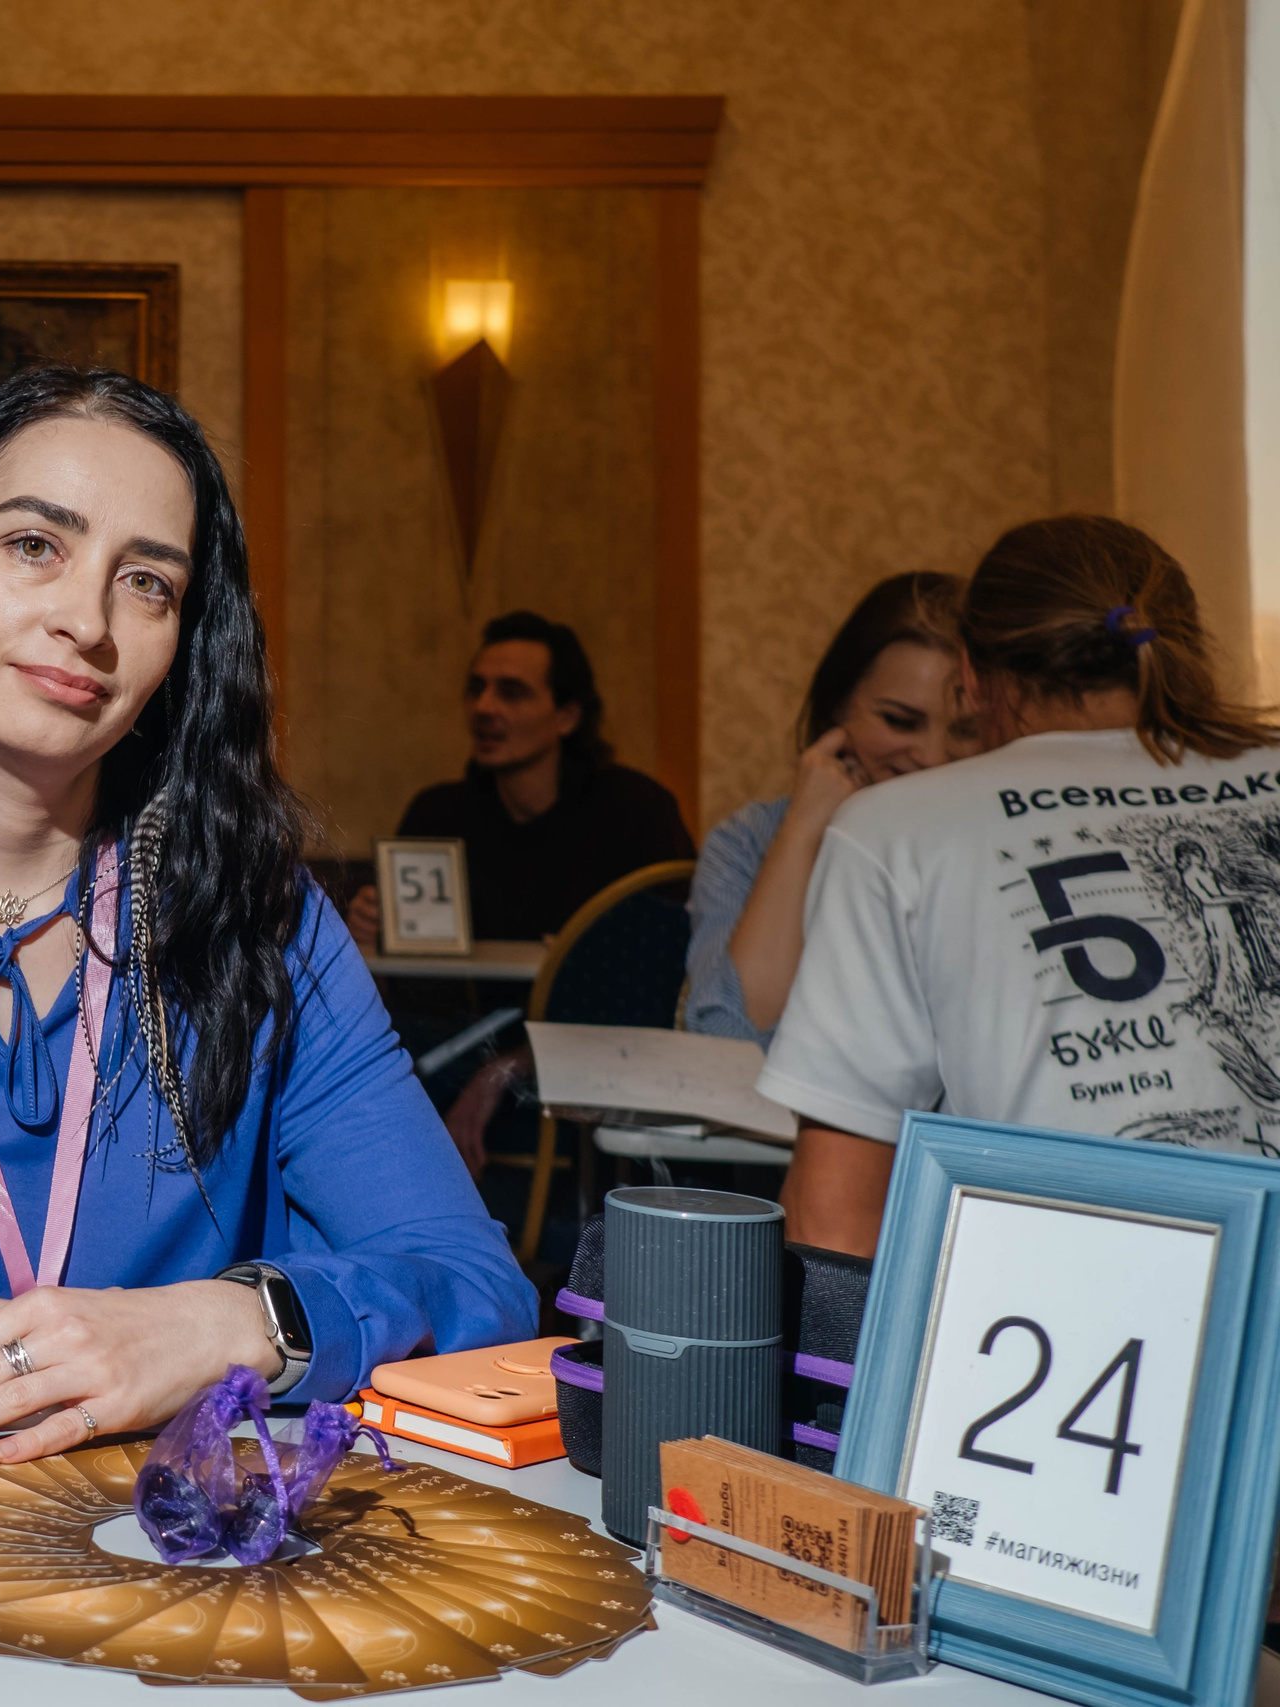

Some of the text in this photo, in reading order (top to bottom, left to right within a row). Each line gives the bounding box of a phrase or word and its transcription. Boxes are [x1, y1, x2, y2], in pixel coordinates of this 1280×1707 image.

[400, 866, 451, 904] 51
[1070, 1068, 1173, 1103] Буки [бэ]
[958, 1315, 1145, 1496] 24
[721, 1481, 732, 1527] Верба
[984, 1531, 1140, 1590] #магияжизни
